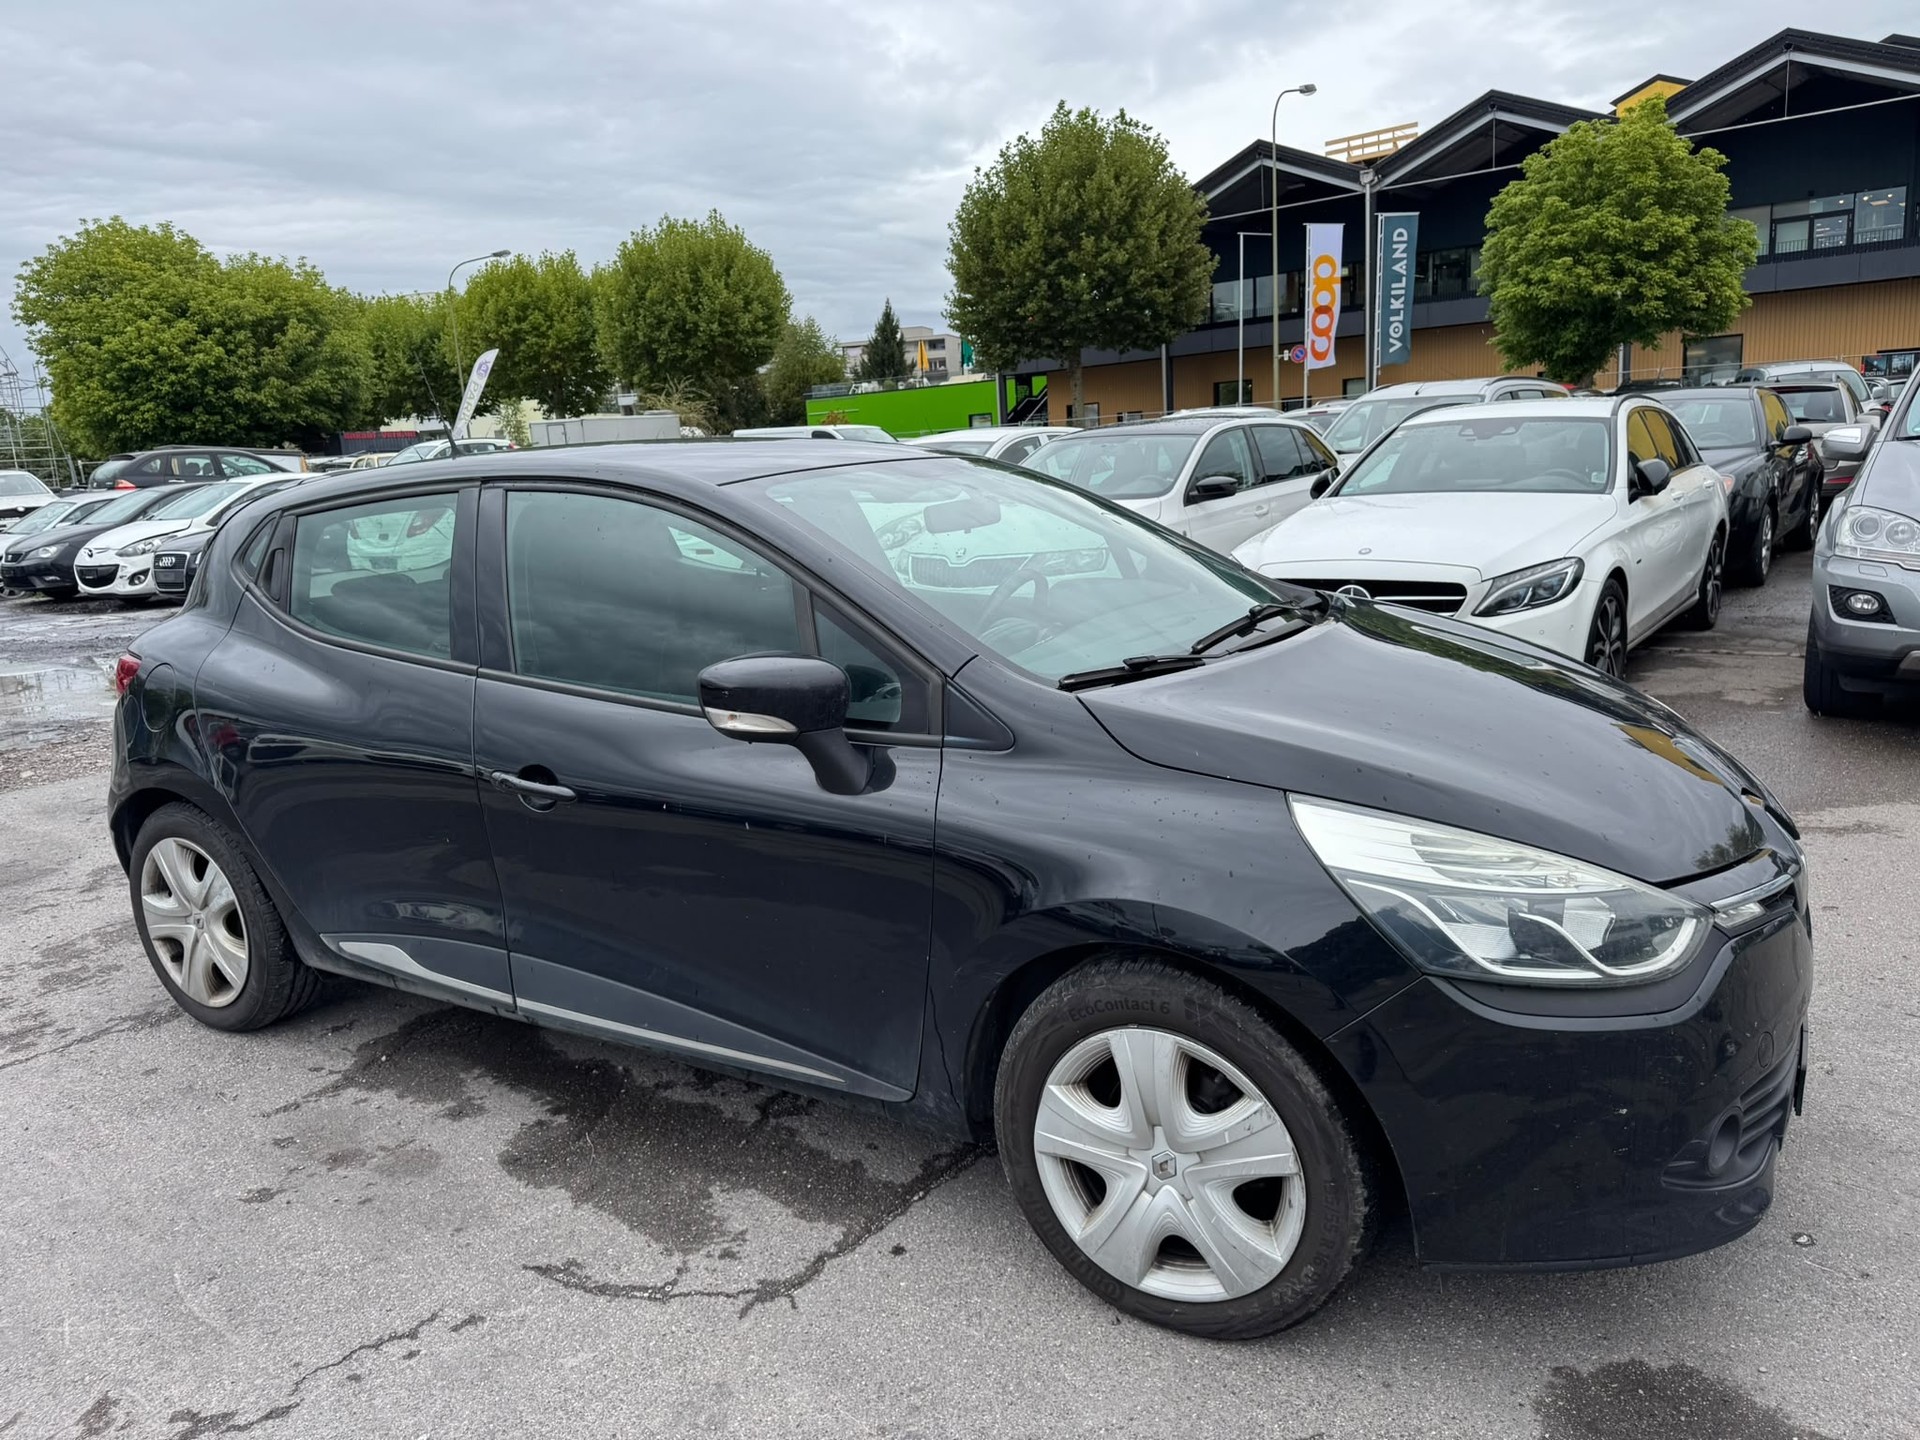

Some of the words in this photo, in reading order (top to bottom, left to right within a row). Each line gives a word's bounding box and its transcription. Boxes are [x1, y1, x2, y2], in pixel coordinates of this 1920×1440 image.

[1310, 254, 1342, 361] coop
[1388, 227, 1408, 354] VOLKILAND
[1068, 998, 1155, 1022] EcoContact
[1159, 1001, 1171, 1015] 6
